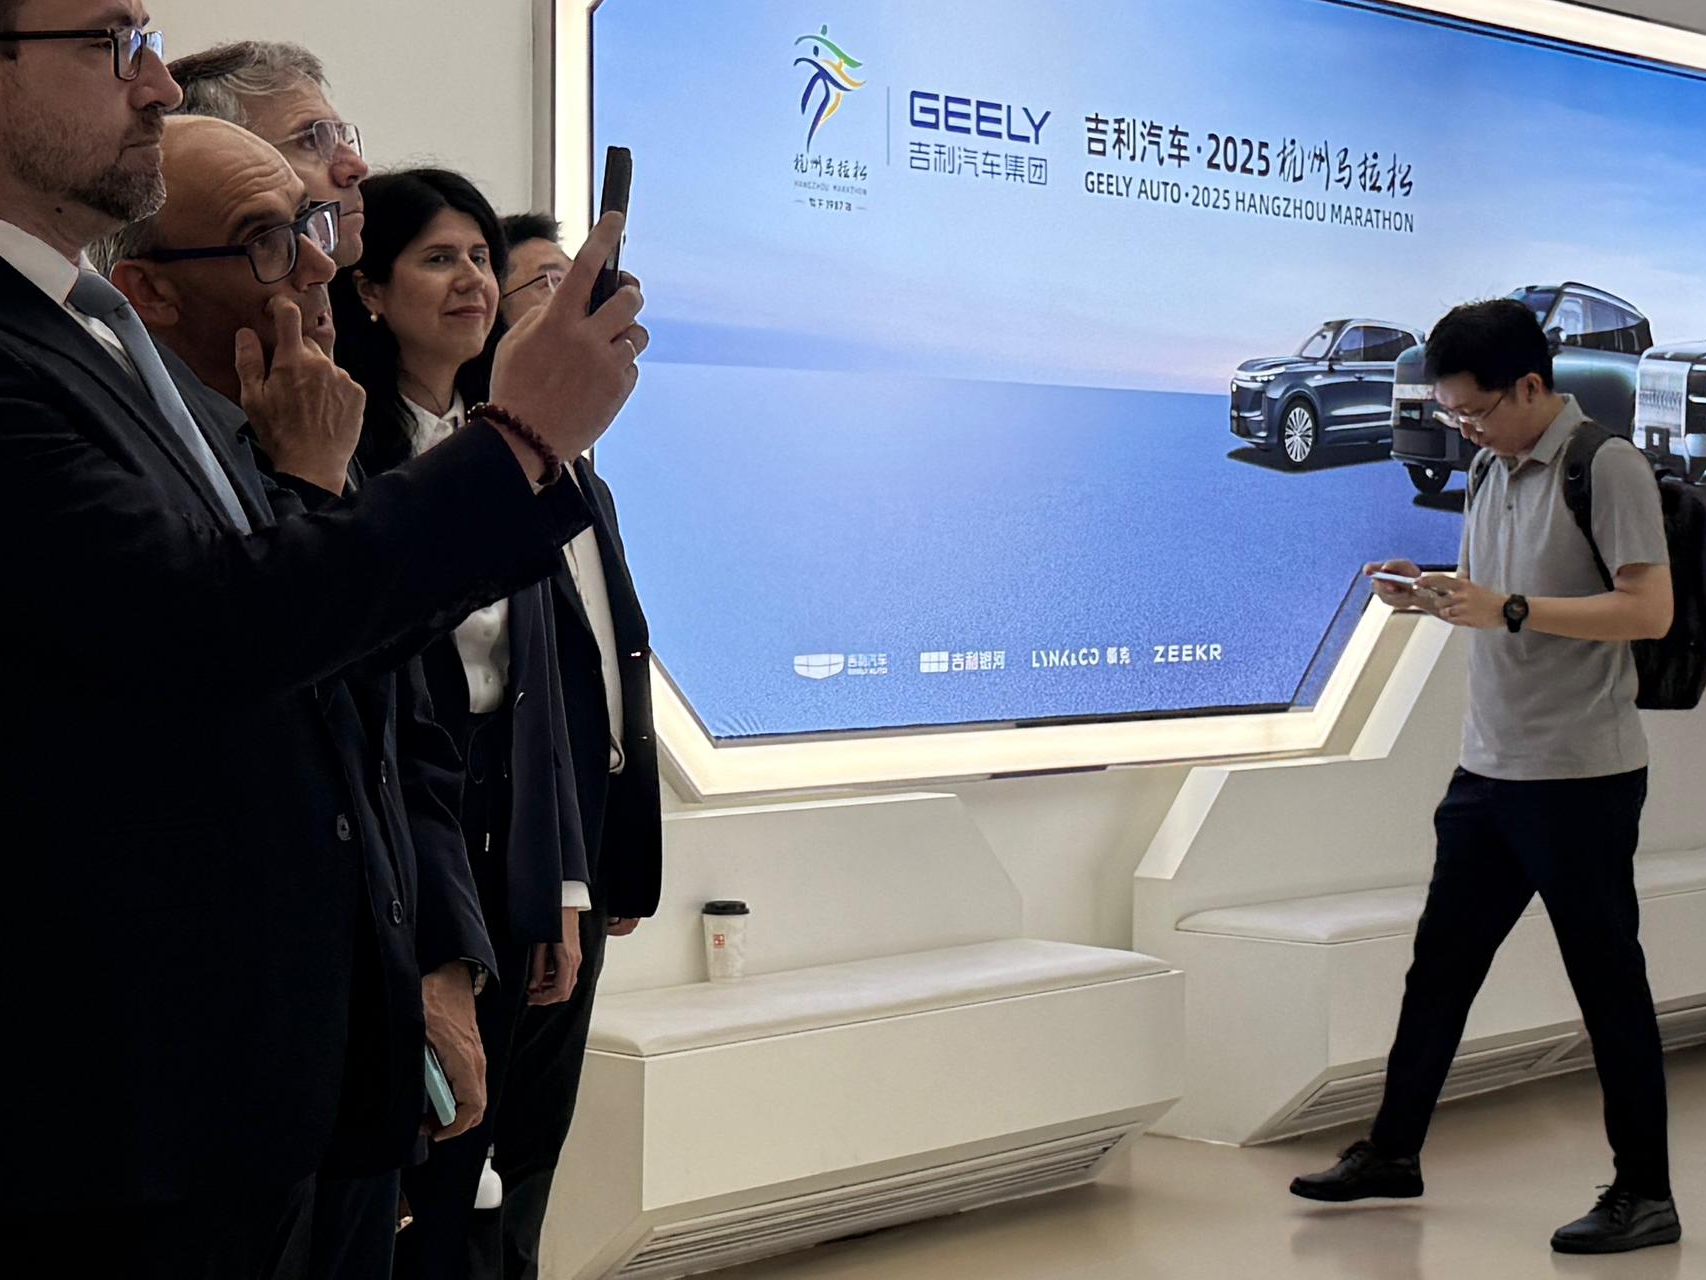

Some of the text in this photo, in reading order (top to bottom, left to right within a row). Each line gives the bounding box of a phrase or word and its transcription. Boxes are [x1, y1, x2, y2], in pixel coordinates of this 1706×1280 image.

[909, 90, 1051, 145] GEELY
[909, 141, 1048, 186] 吉利汽车集团
[1084, 171, 1133, 198] GEELY
[1235, 190, 1327, 222] HANGZHOU
[1330, 203, 1414, 233] MARATHON
[1153, 643, 1222, 663] ZEEKR
